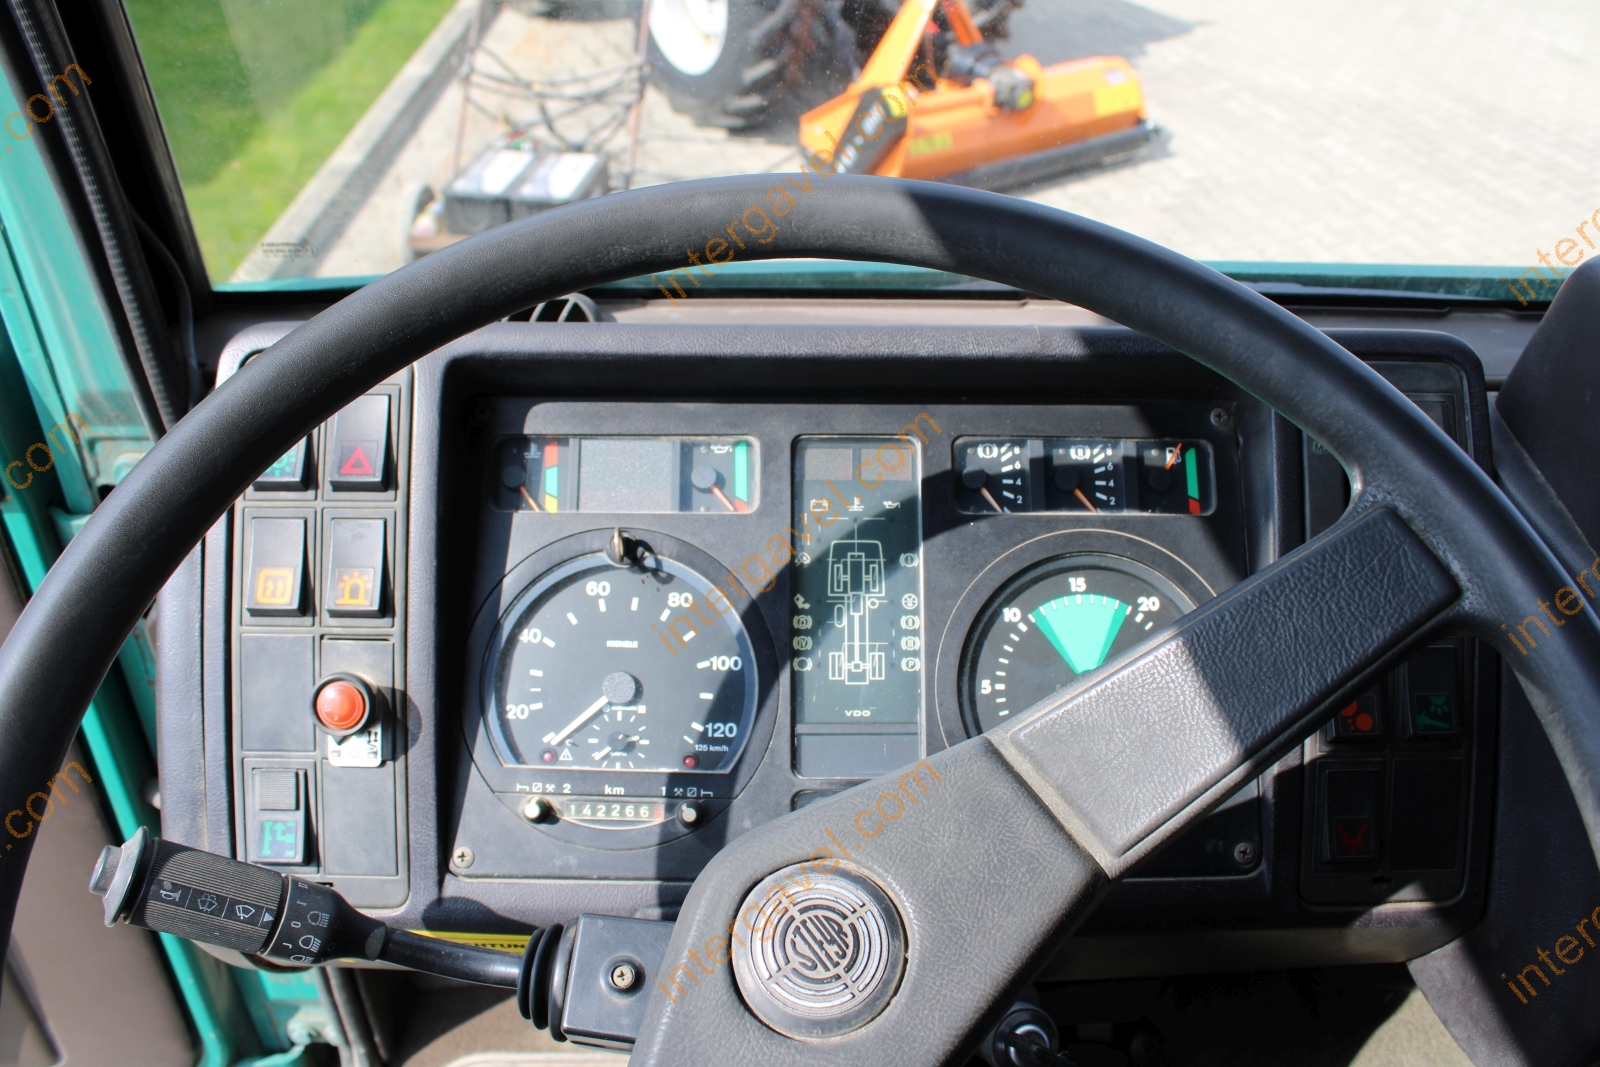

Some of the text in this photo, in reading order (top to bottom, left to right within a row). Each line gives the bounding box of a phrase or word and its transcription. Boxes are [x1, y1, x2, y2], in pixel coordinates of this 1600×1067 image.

[1013, 446, 1020, 455] 8
[1106, 447, 1113, 456] 8
[1014, 461, 1021, 470] 6
[1106, 462, 1113, 471] 6
[1015, 478, 1022, 486] 4
[1108, 479, 1114, 487] 4
[1016, 495, 1023, 504] 2
[1109, 497, 1116, 505] 2
[586, 581, 611, 596] 60
[1069, 578, 1086, 592] 15
[667, 592, 693, 608] 80
[1138, 597, 1160, 612] 20
[1002, 608, 1021, 622] 10
[518, 628, 542, 644] 40
[606, 639, 639, 649] KIENZLE
[709, 656, 742, 671] 100
[981, 680, 991, 694] 5
[506, 704, 529, 720] 20
[704, 723, 738, 738] 120
[694, 744, 729, 752] 125 km/h
[562, 783, 571, 794] 2
[604, 784, 625, 796] km
